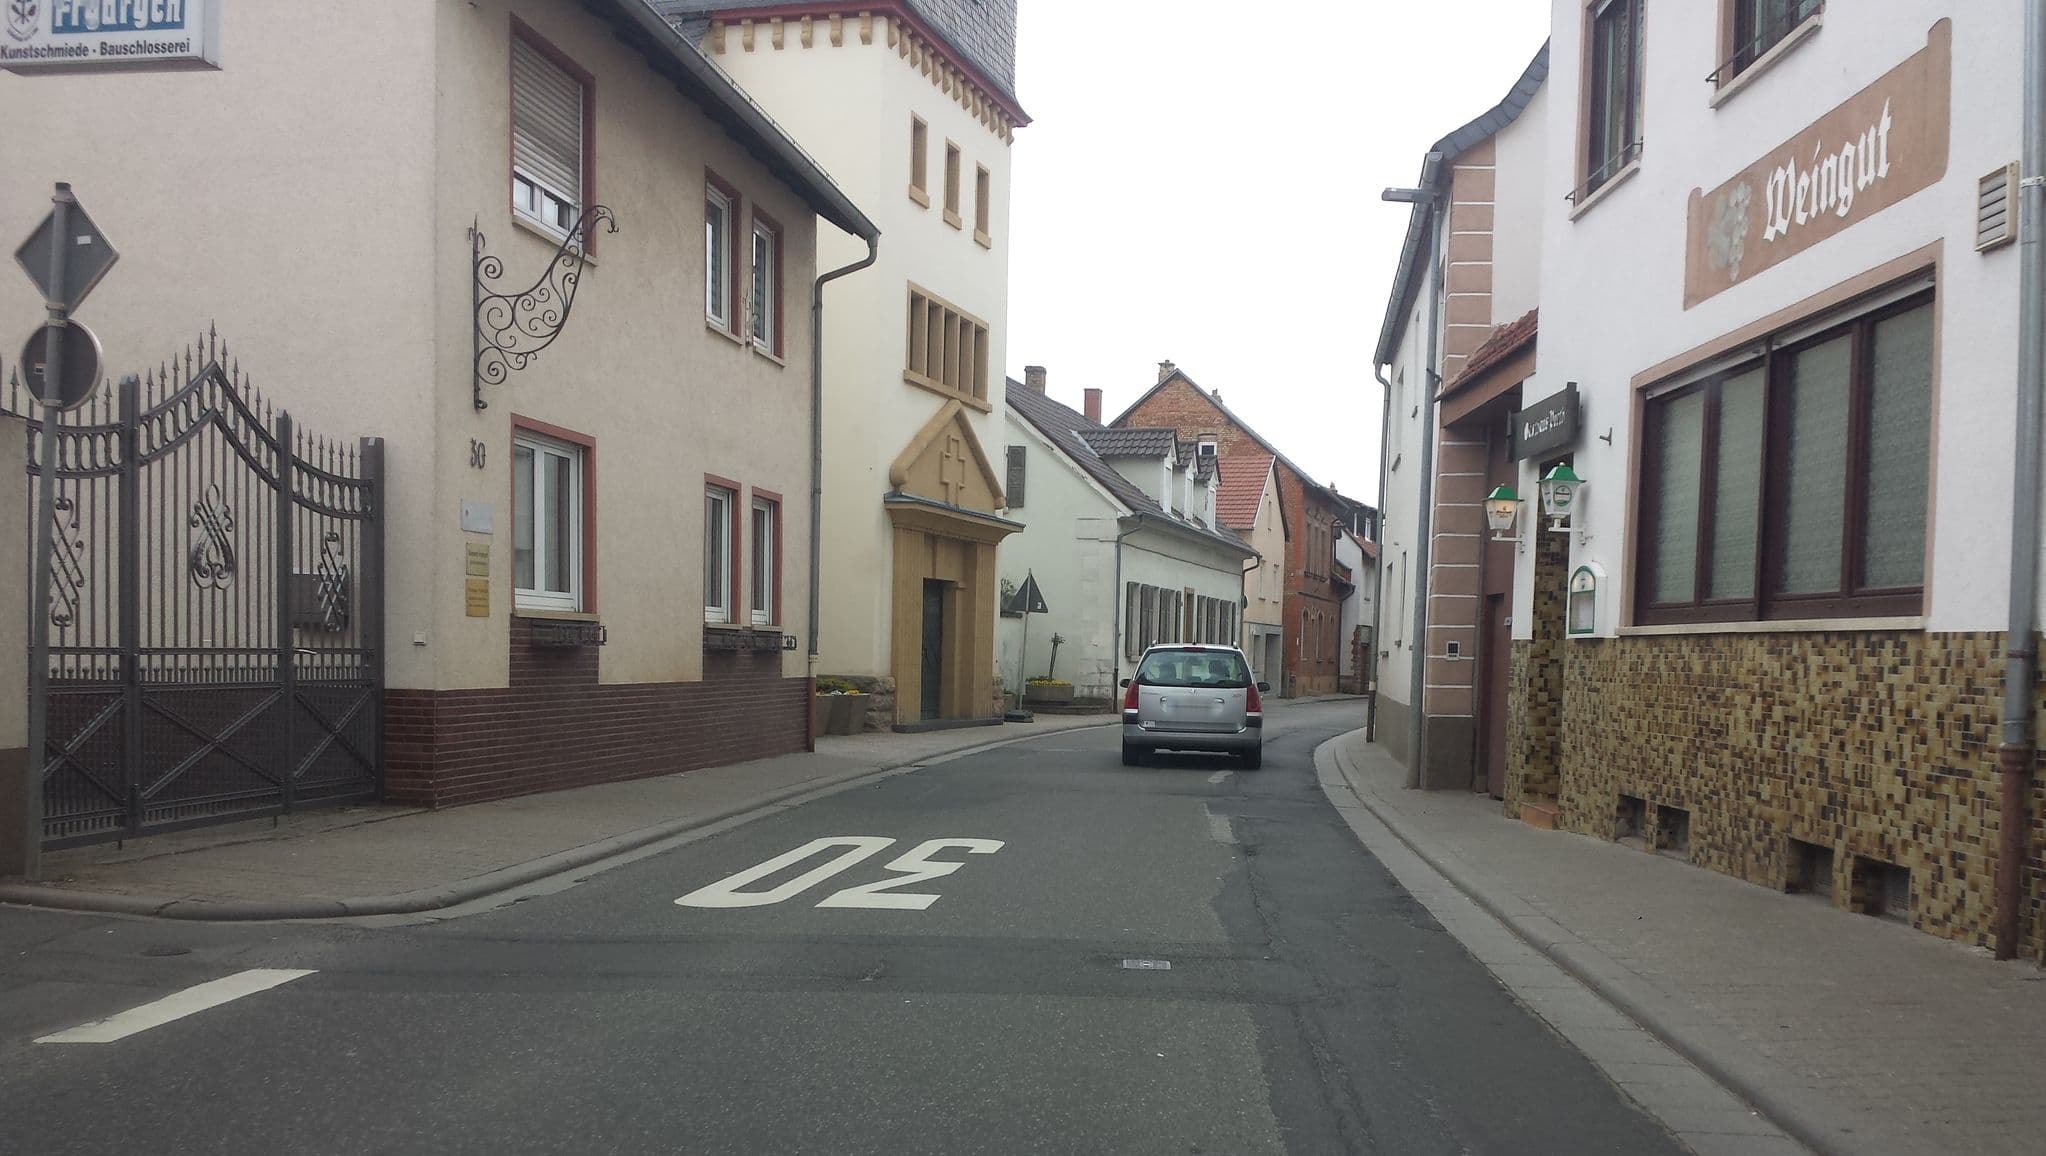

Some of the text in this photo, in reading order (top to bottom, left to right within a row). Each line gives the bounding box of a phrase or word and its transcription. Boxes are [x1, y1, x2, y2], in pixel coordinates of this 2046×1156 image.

[0, 38, 190, 59] Kunstschmiede Bauschlosserei
[1763, 97, 1892, 242] Weingut
[470, 437, 486, 469] 30
